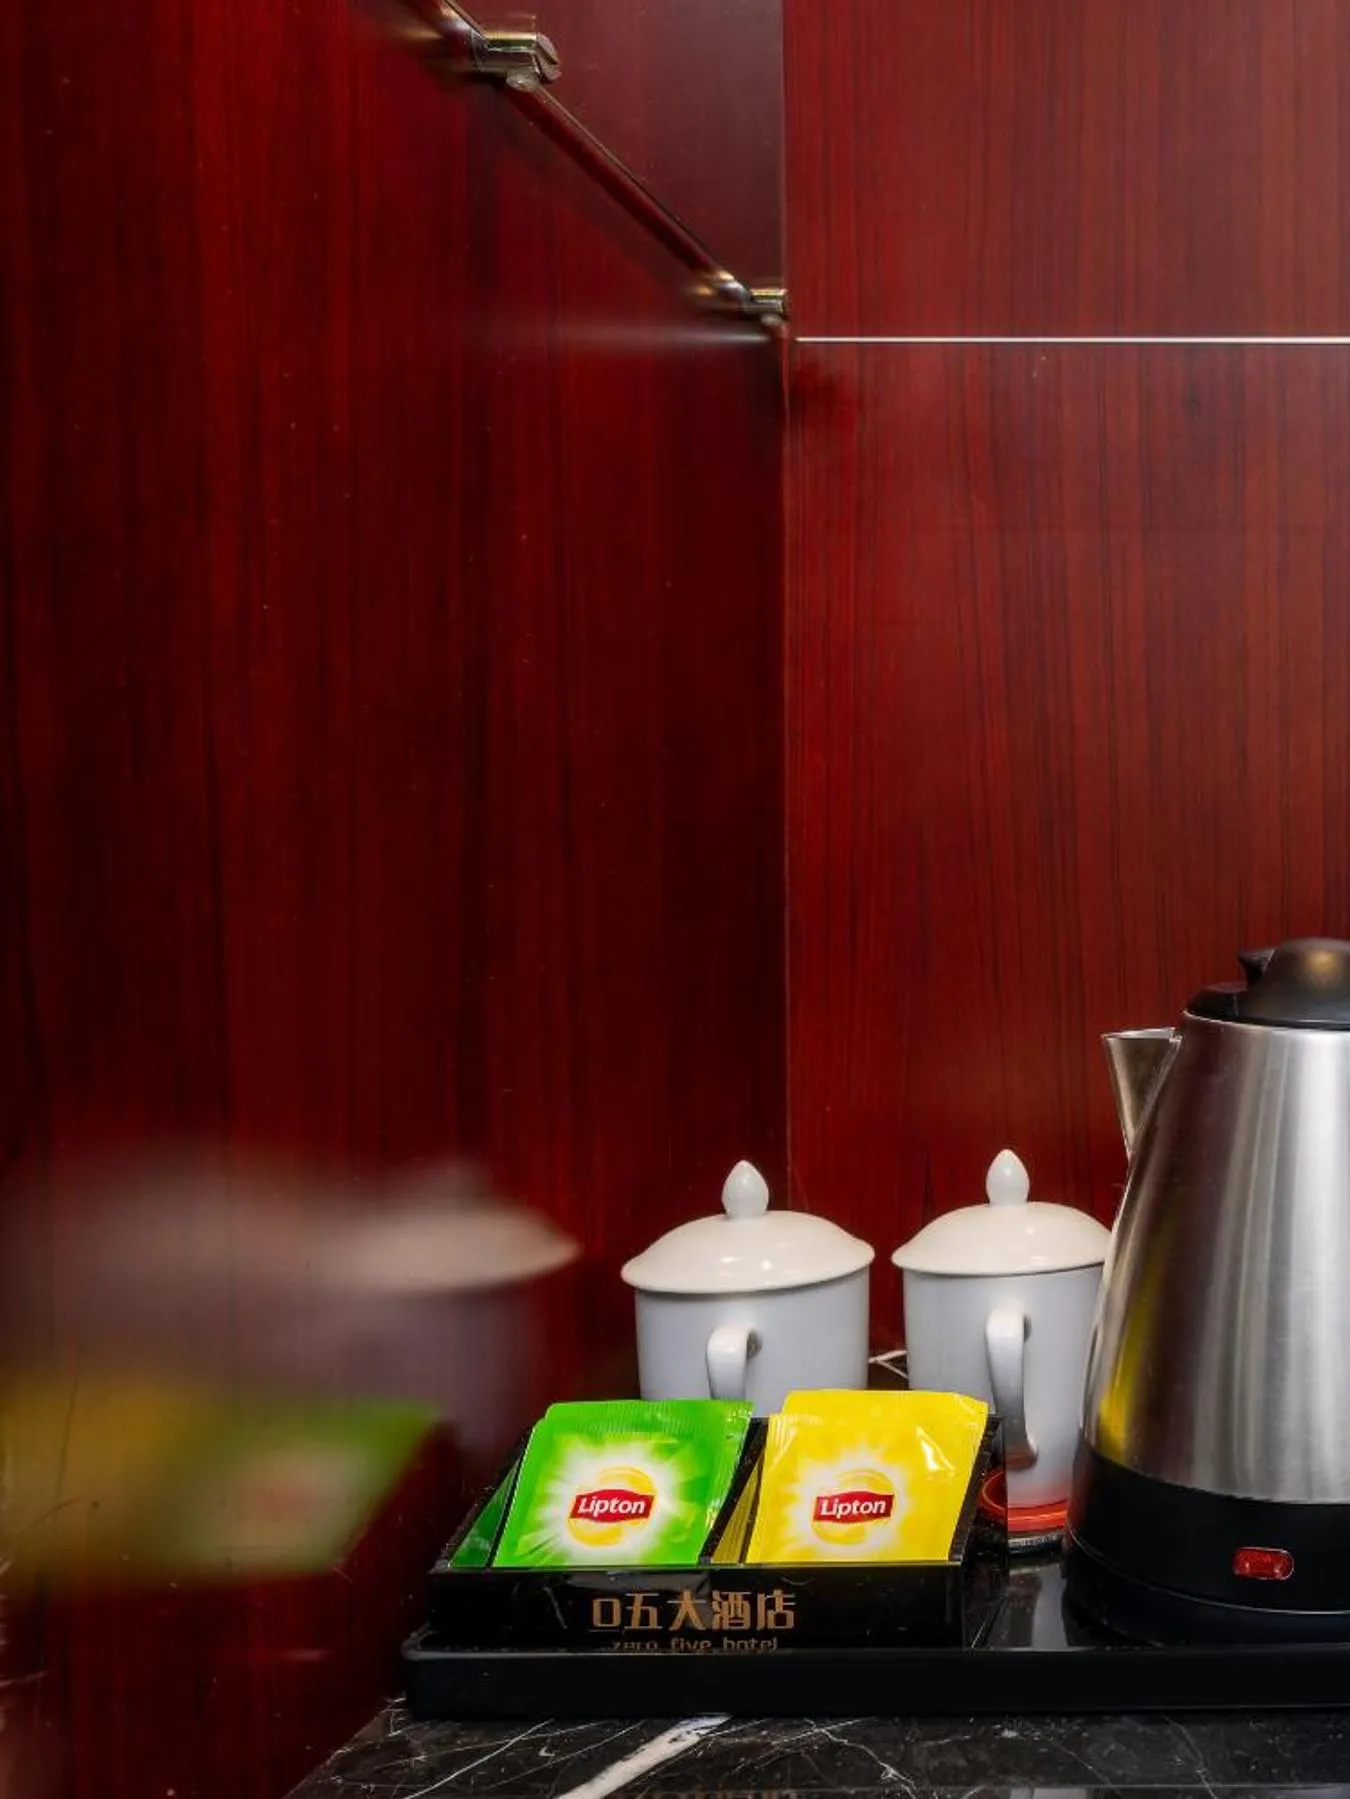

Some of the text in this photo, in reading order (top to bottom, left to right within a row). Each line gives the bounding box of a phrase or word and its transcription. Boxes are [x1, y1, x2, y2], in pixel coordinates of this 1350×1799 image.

[577, 1495, 647, 1519] Lipton
[819, 1498, 886, 1519] Lipton
[670, 1637, 712, 1651] five
